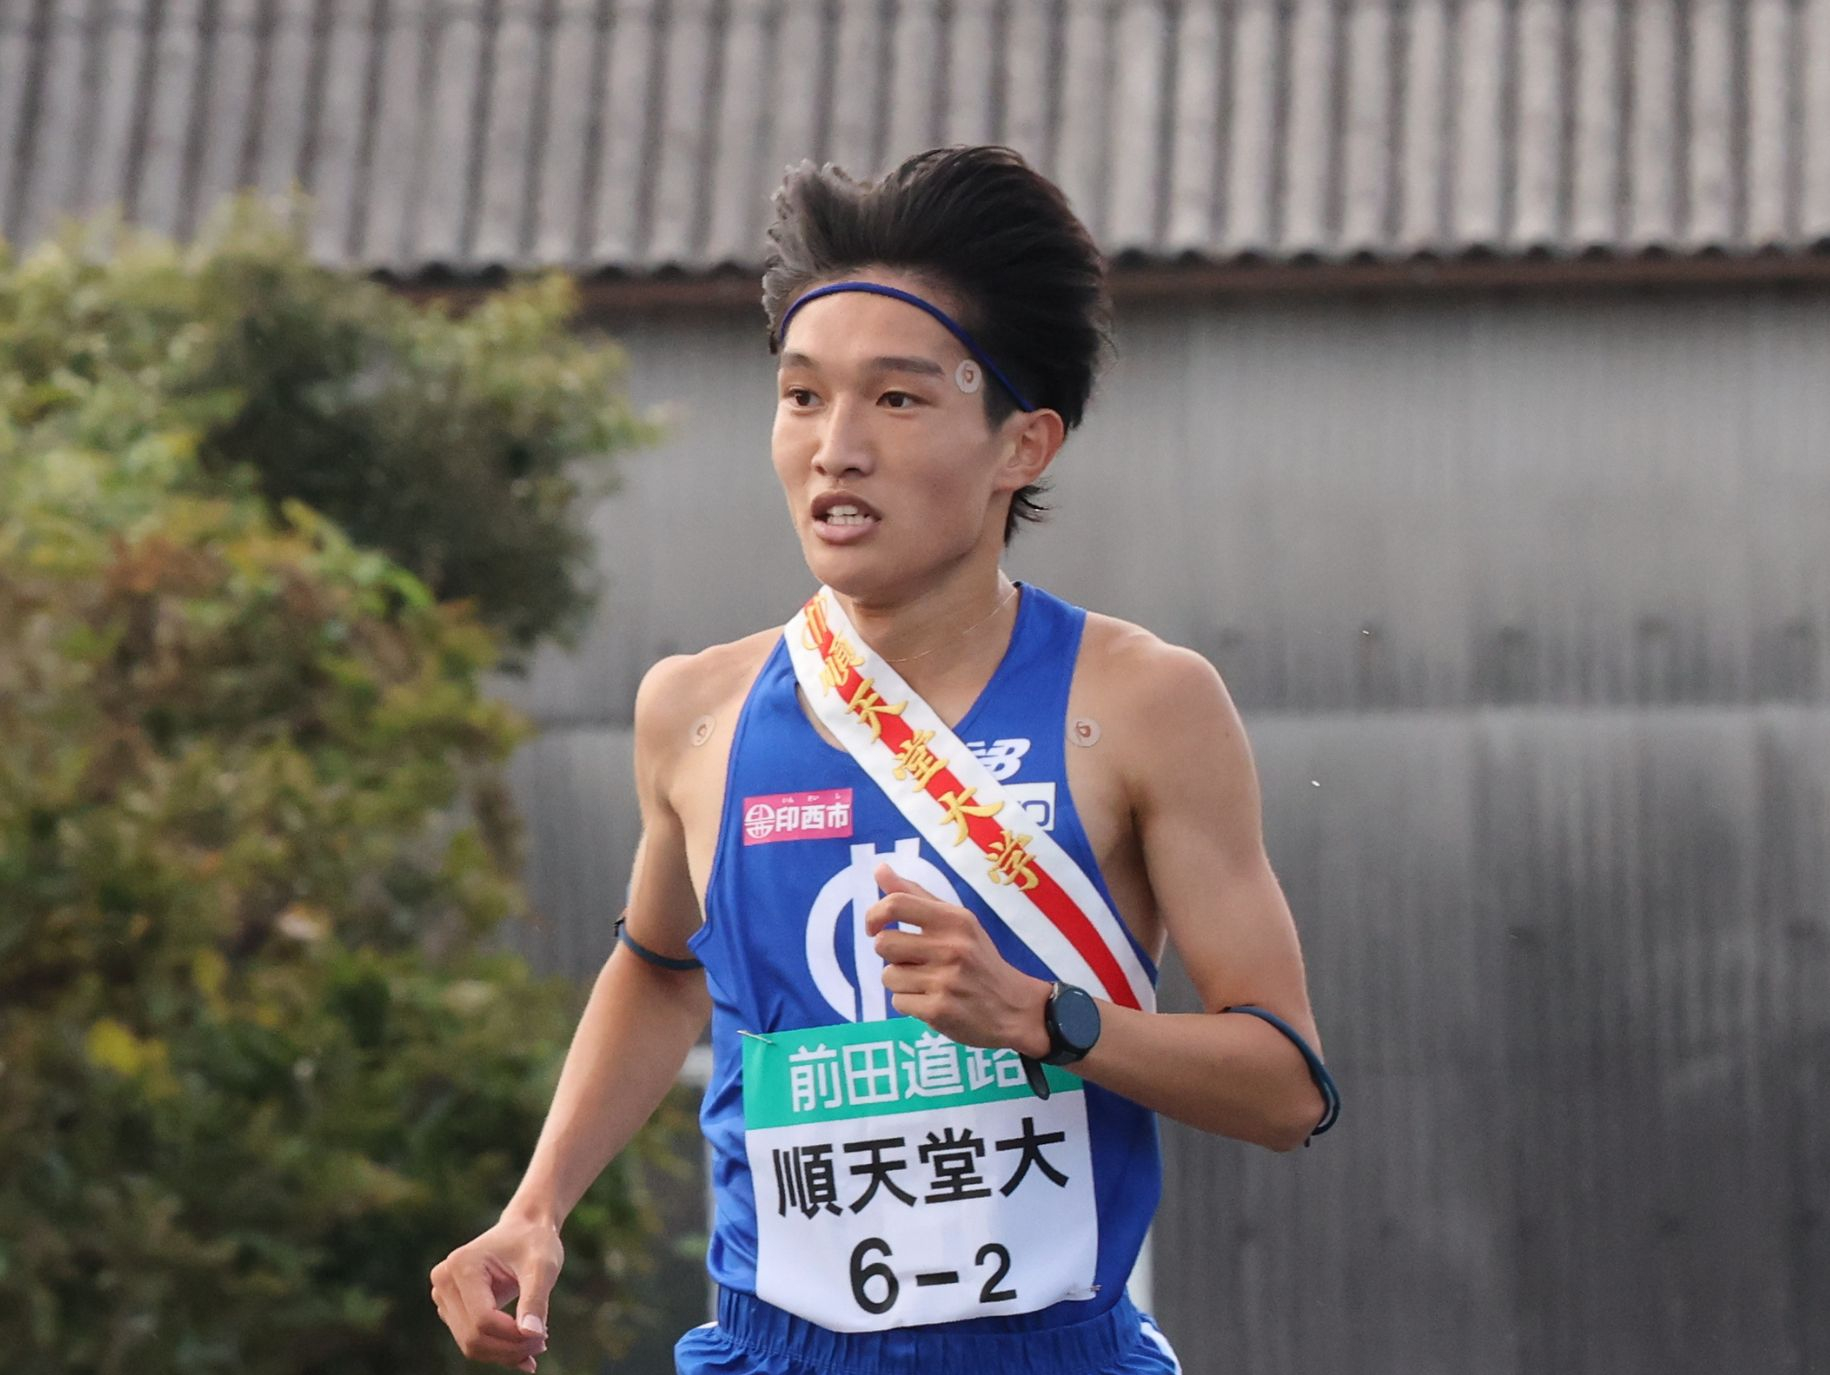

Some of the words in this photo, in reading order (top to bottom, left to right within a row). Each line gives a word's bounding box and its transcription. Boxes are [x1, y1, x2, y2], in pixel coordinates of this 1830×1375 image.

[775, 803, 850, 832] 印西市
[788, 1031, 1028, 1113] 前田道路
[772, 1117, 1070, 1219] 順天堂大
